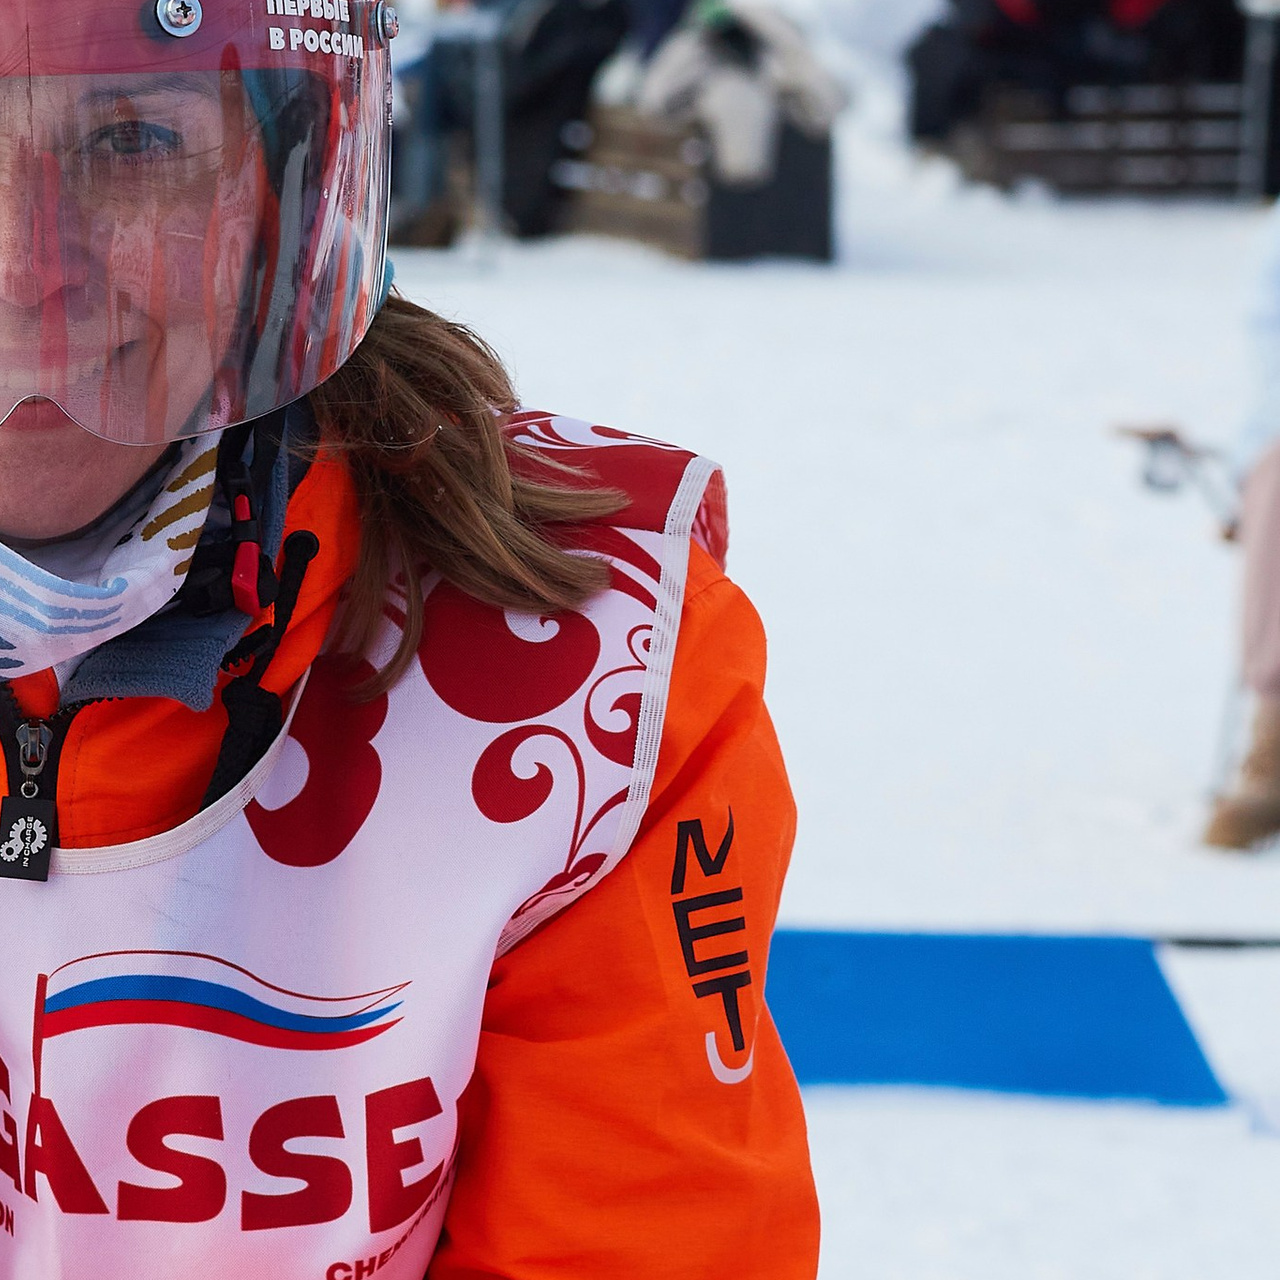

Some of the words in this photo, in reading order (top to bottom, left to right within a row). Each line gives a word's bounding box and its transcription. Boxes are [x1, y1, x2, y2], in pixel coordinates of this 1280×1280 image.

[269, 27, 285, 50] В
[289, 28, 364, 59] РОССИИ
[23, 816, 34, 856] CHARGE
[22, 857, 30, 867] IN
